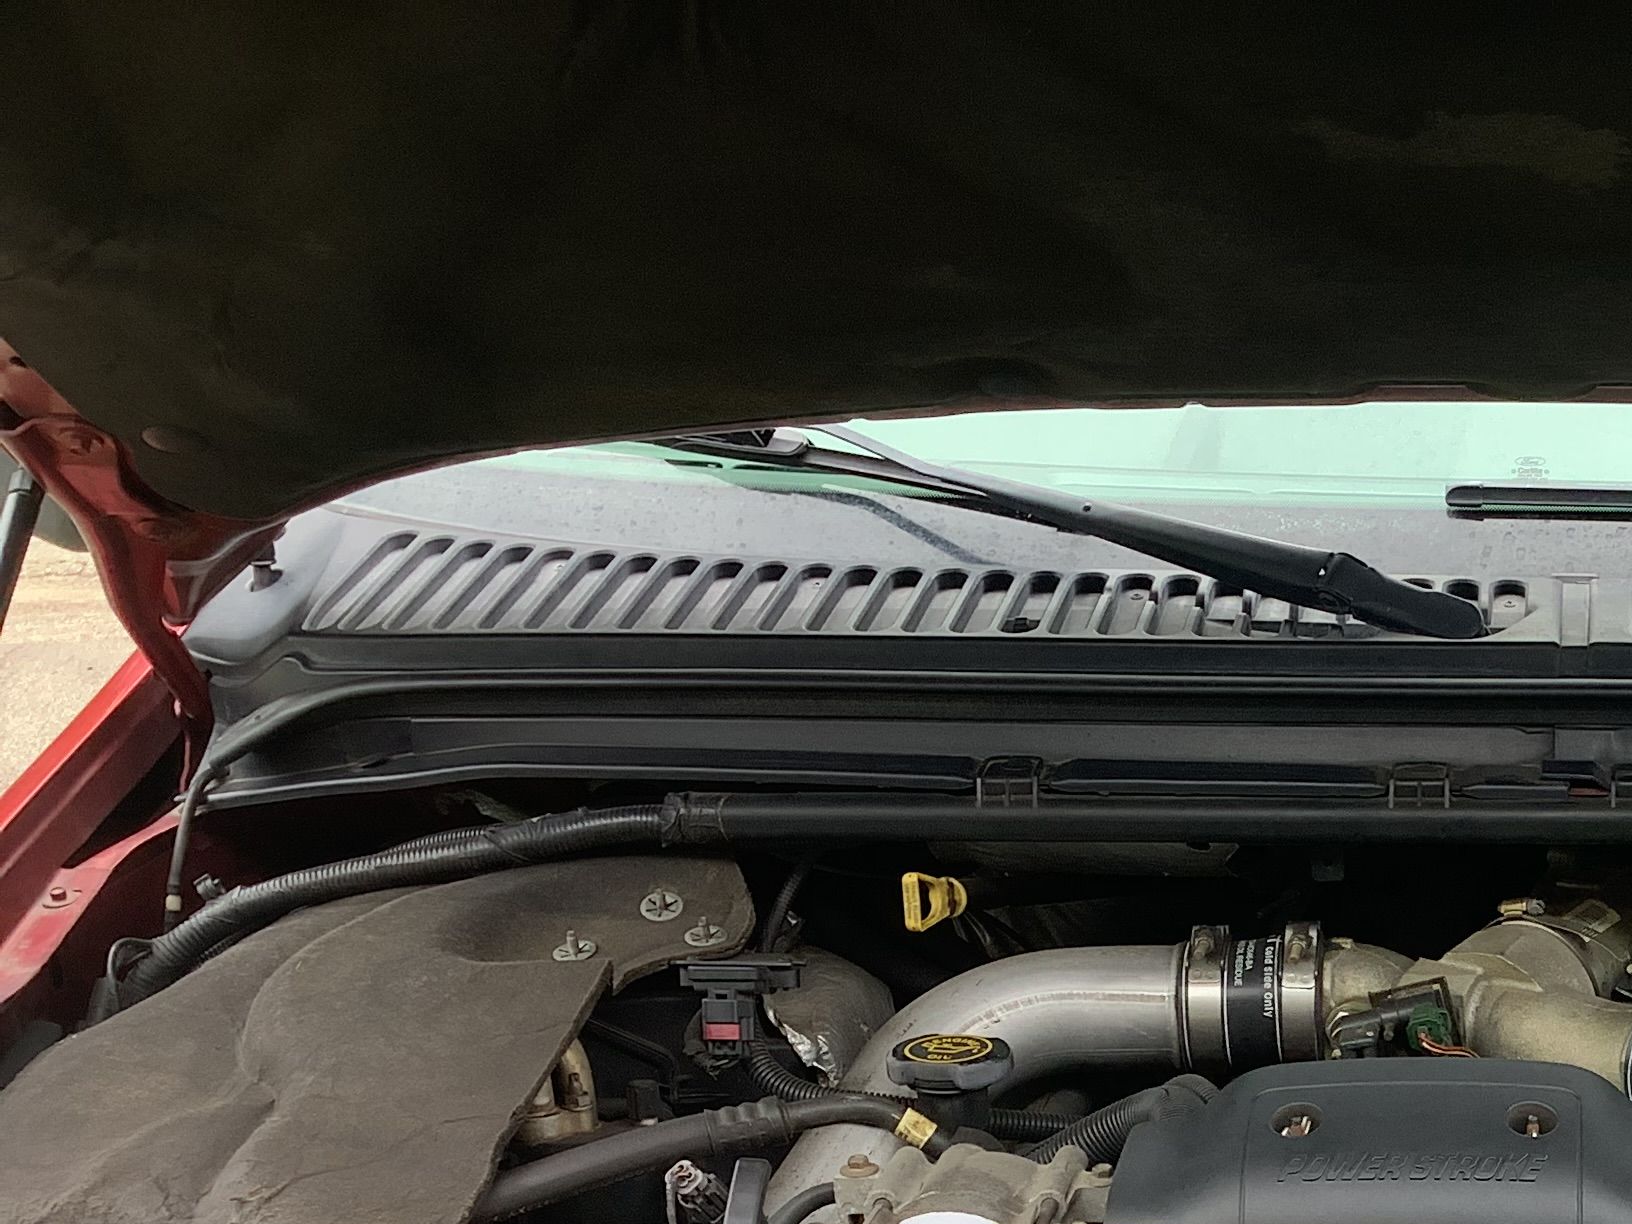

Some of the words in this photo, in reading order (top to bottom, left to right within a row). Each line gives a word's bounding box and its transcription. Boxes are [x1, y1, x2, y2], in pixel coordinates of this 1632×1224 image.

[1264, 946, 1275, 965] Cold
[1263, 991, 1275, 1018] Only
[1276, 1153, 1408, 1183] POWER
[1409, 1153, 1549, 1183] STROKE
